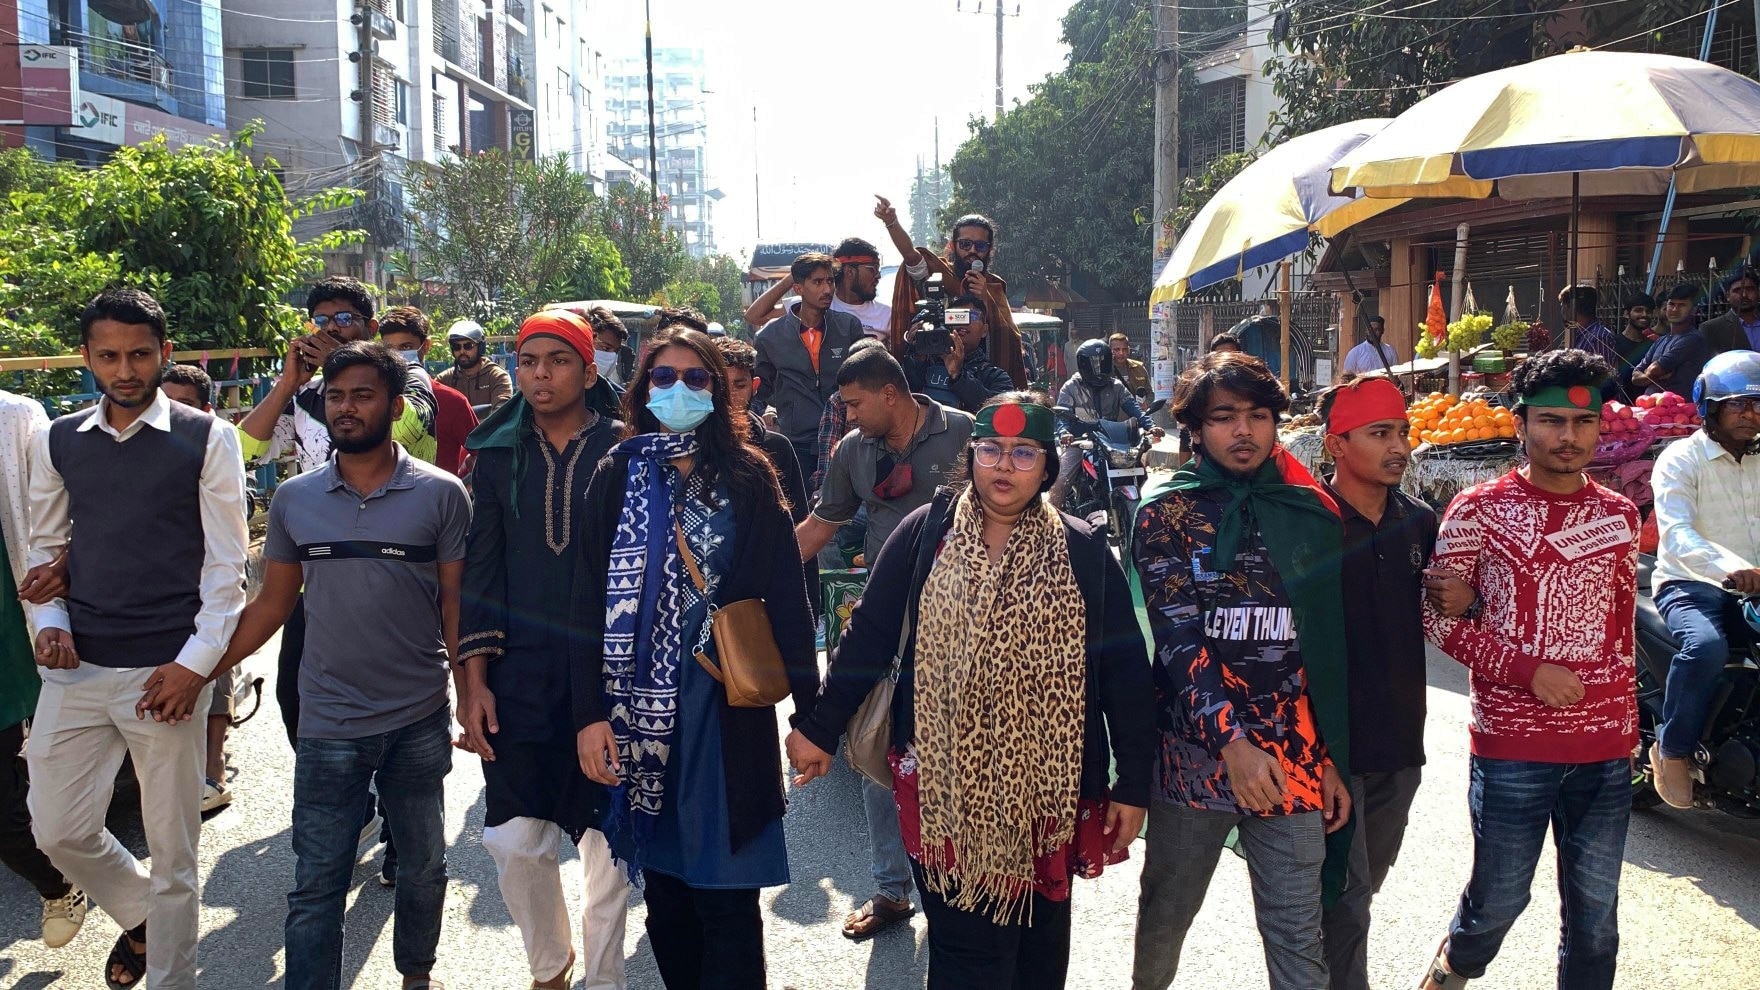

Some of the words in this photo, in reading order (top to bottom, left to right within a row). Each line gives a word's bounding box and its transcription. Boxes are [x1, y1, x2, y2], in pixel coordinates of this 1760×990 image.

[100, 111, 118, 128] IFIC
[1554, 520, 1626, 549] UNLIMITED
[1579, 534, 1620, 553] position
[382, 548, 405, 556] adidas
